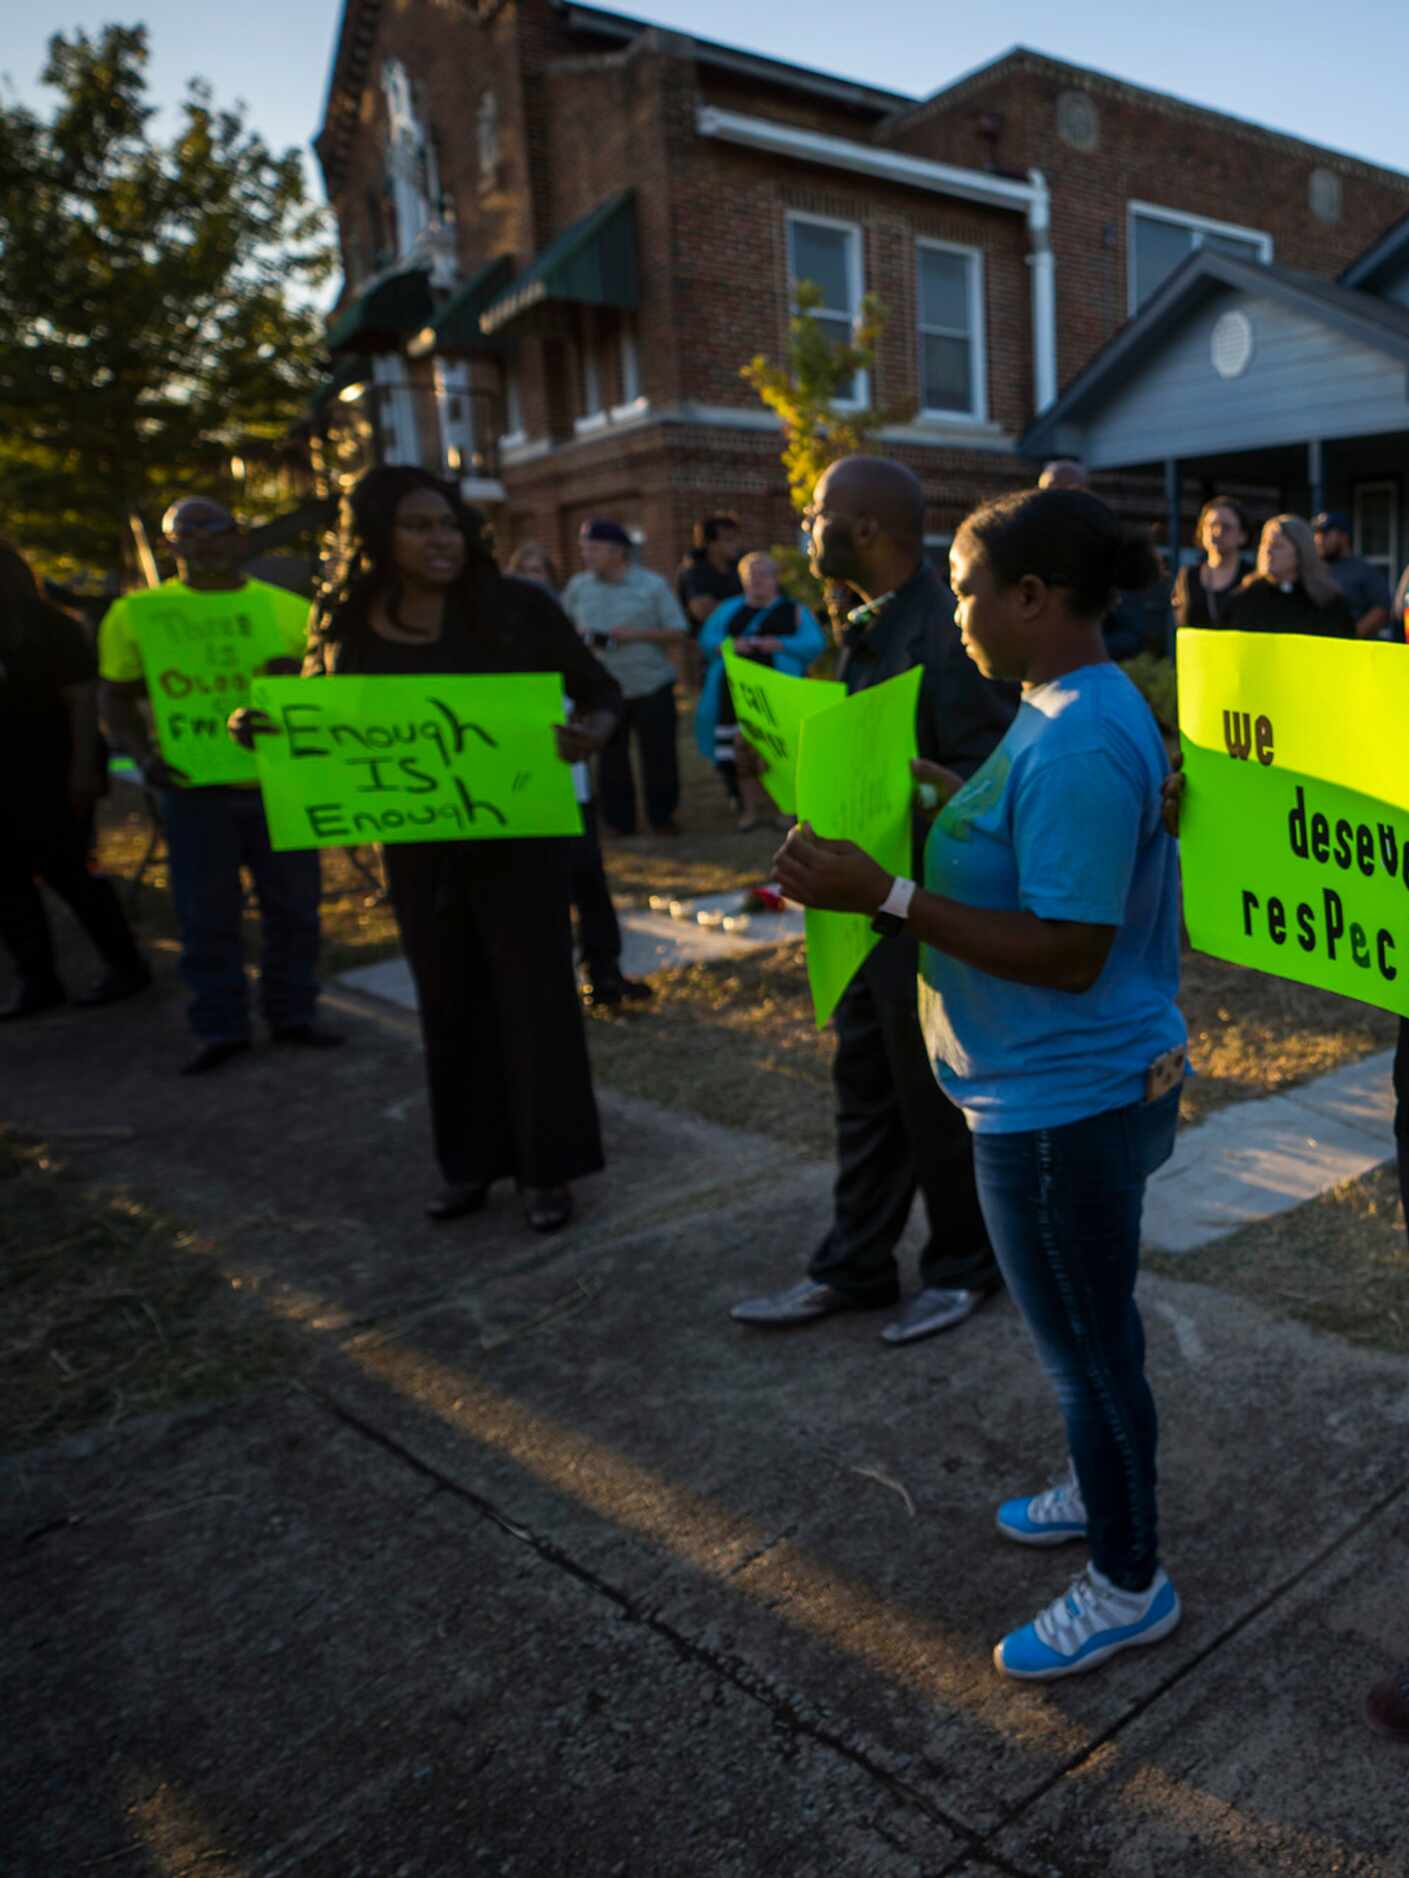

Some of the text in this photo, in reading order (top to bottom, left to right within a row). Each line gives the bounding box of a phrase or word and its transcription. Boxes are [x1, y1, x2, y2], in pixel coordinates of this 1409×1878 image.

[282, 696, 498, 768] Enough
[1223, 709, 1275, 767] we
[344, 755, 439, 794] IS
[304, 775, 508, 839] Enough
